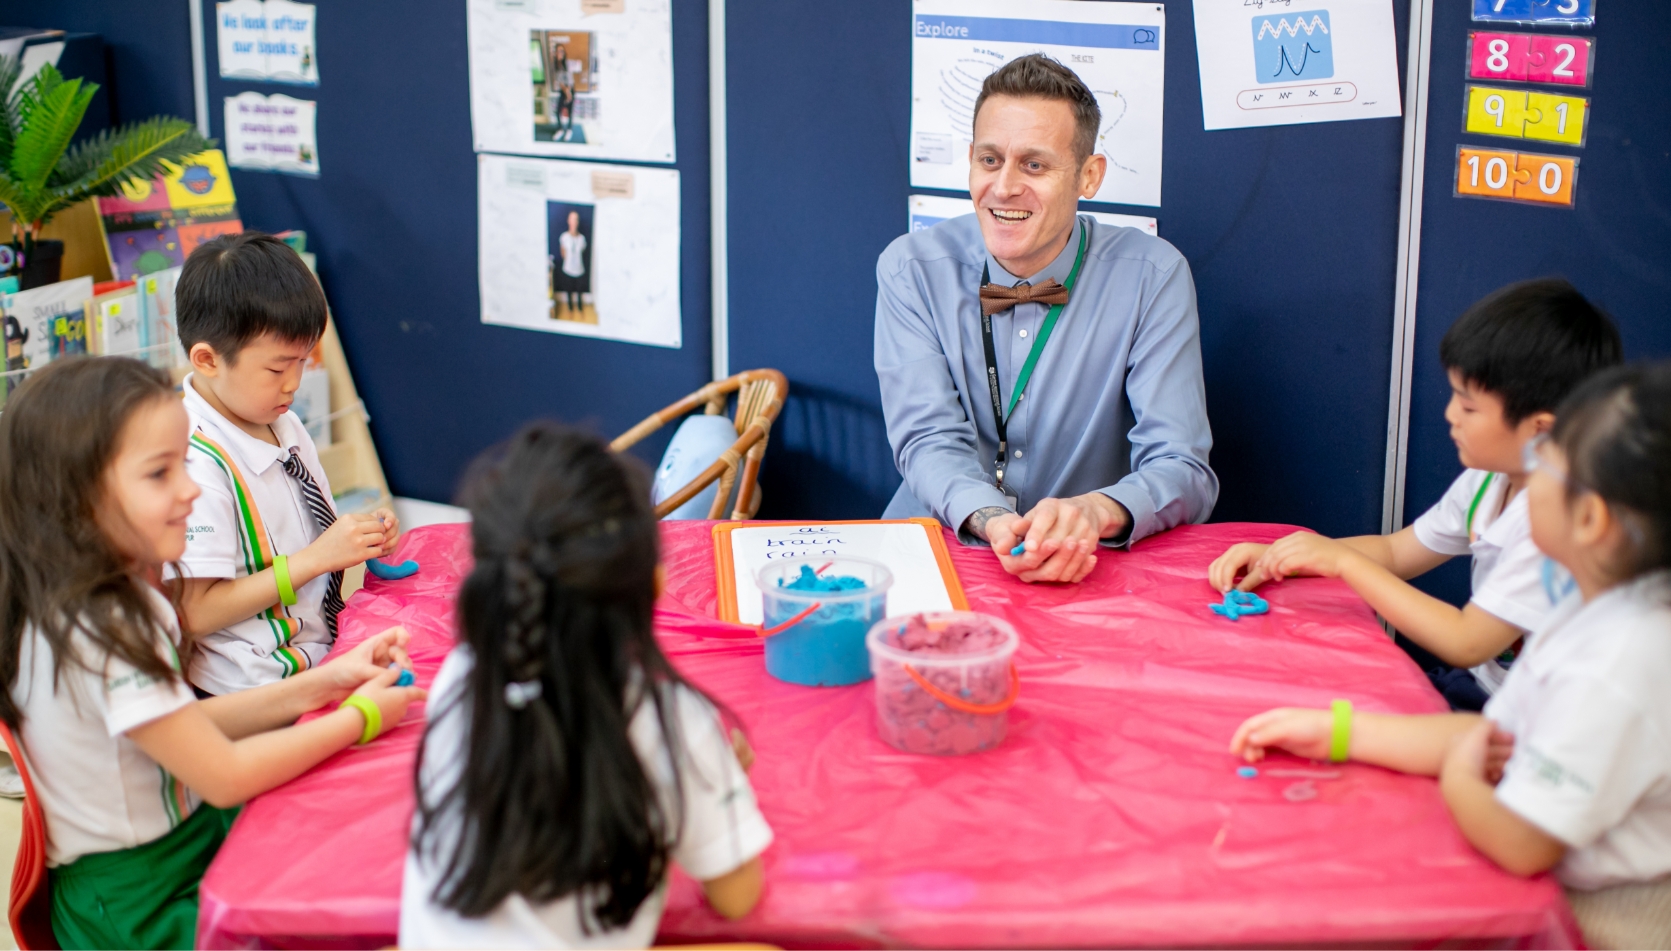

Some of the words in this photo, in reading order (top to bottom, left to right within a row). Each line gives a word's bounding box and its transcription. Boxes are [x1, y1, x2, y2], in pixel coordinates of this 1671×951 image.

[272, 14, 308, 31] after
[916, 21, 969, 38] Explore
[1486, 39, 1510, 73] 8
[1552, 43, 1576, 77] 2
[1484, 94, 1506, 128] 9
[1555, 102, 1568, 135] 1
[1467, 155, 1508, 190] 10
[1538, 162, 1563, 196] 0
[195, 525, 215, 533] SCHOOL
[767, 536, 847, 548] train
[767, 549, 837, 559] rain
